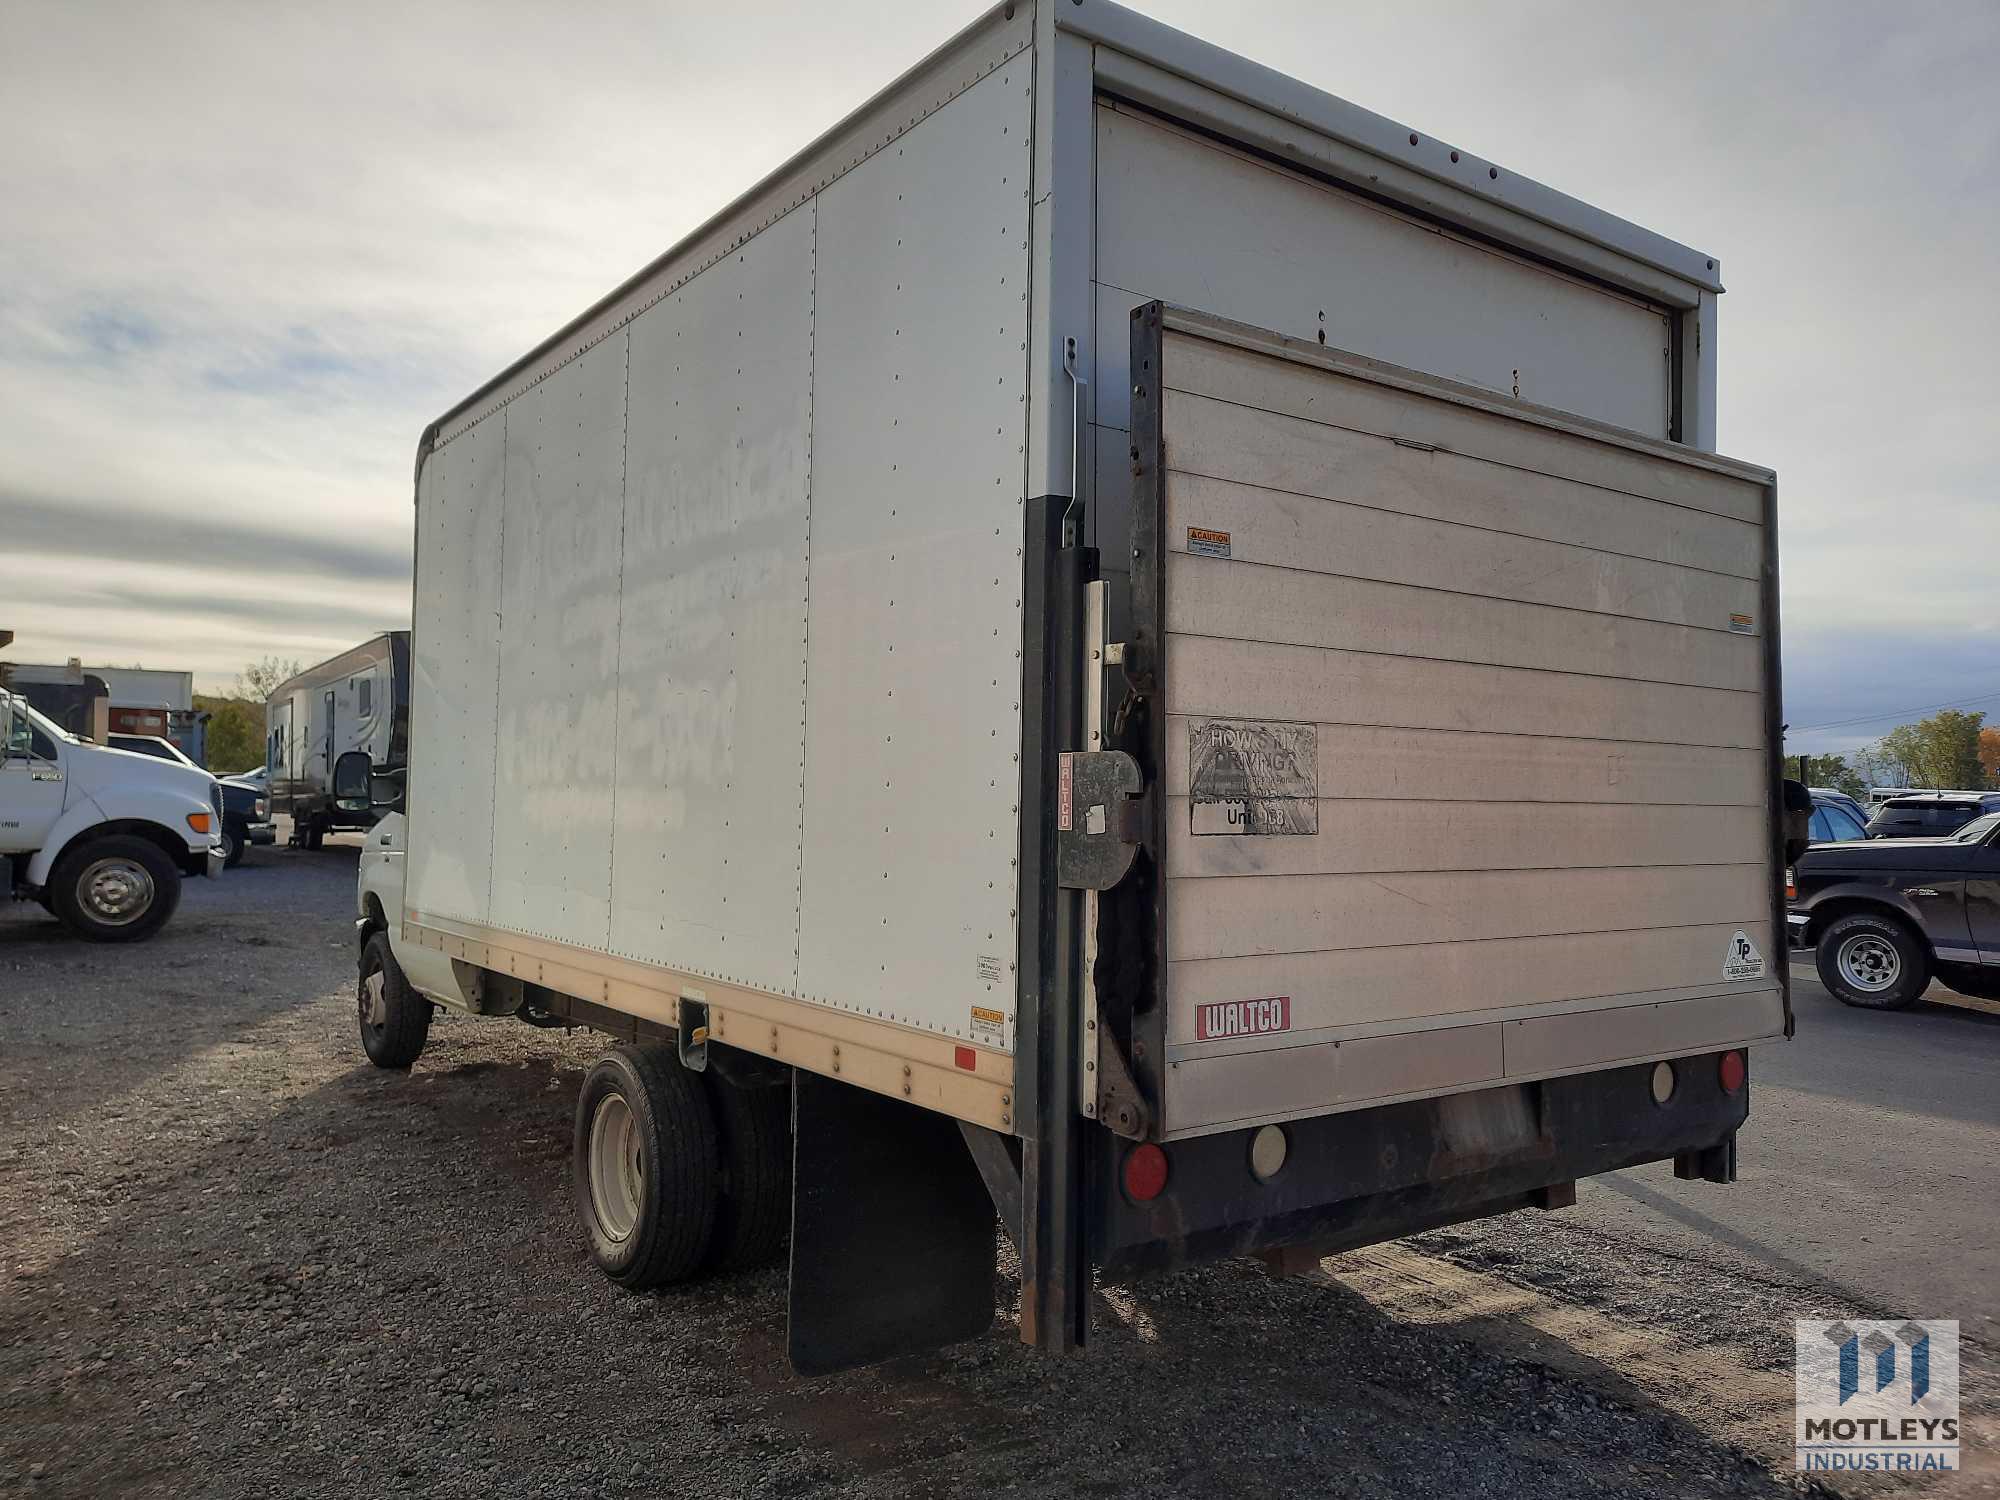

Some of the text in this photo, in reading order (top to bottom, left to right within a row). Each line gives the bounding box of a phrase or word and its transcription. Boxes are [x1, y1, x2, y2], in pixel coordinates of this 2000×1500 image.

[1197, 531, 1228, 543] CAUTION
[1059, 754, 1071, 828] WALTCO
[1205, 998, 1282, 1038] WALTCO
